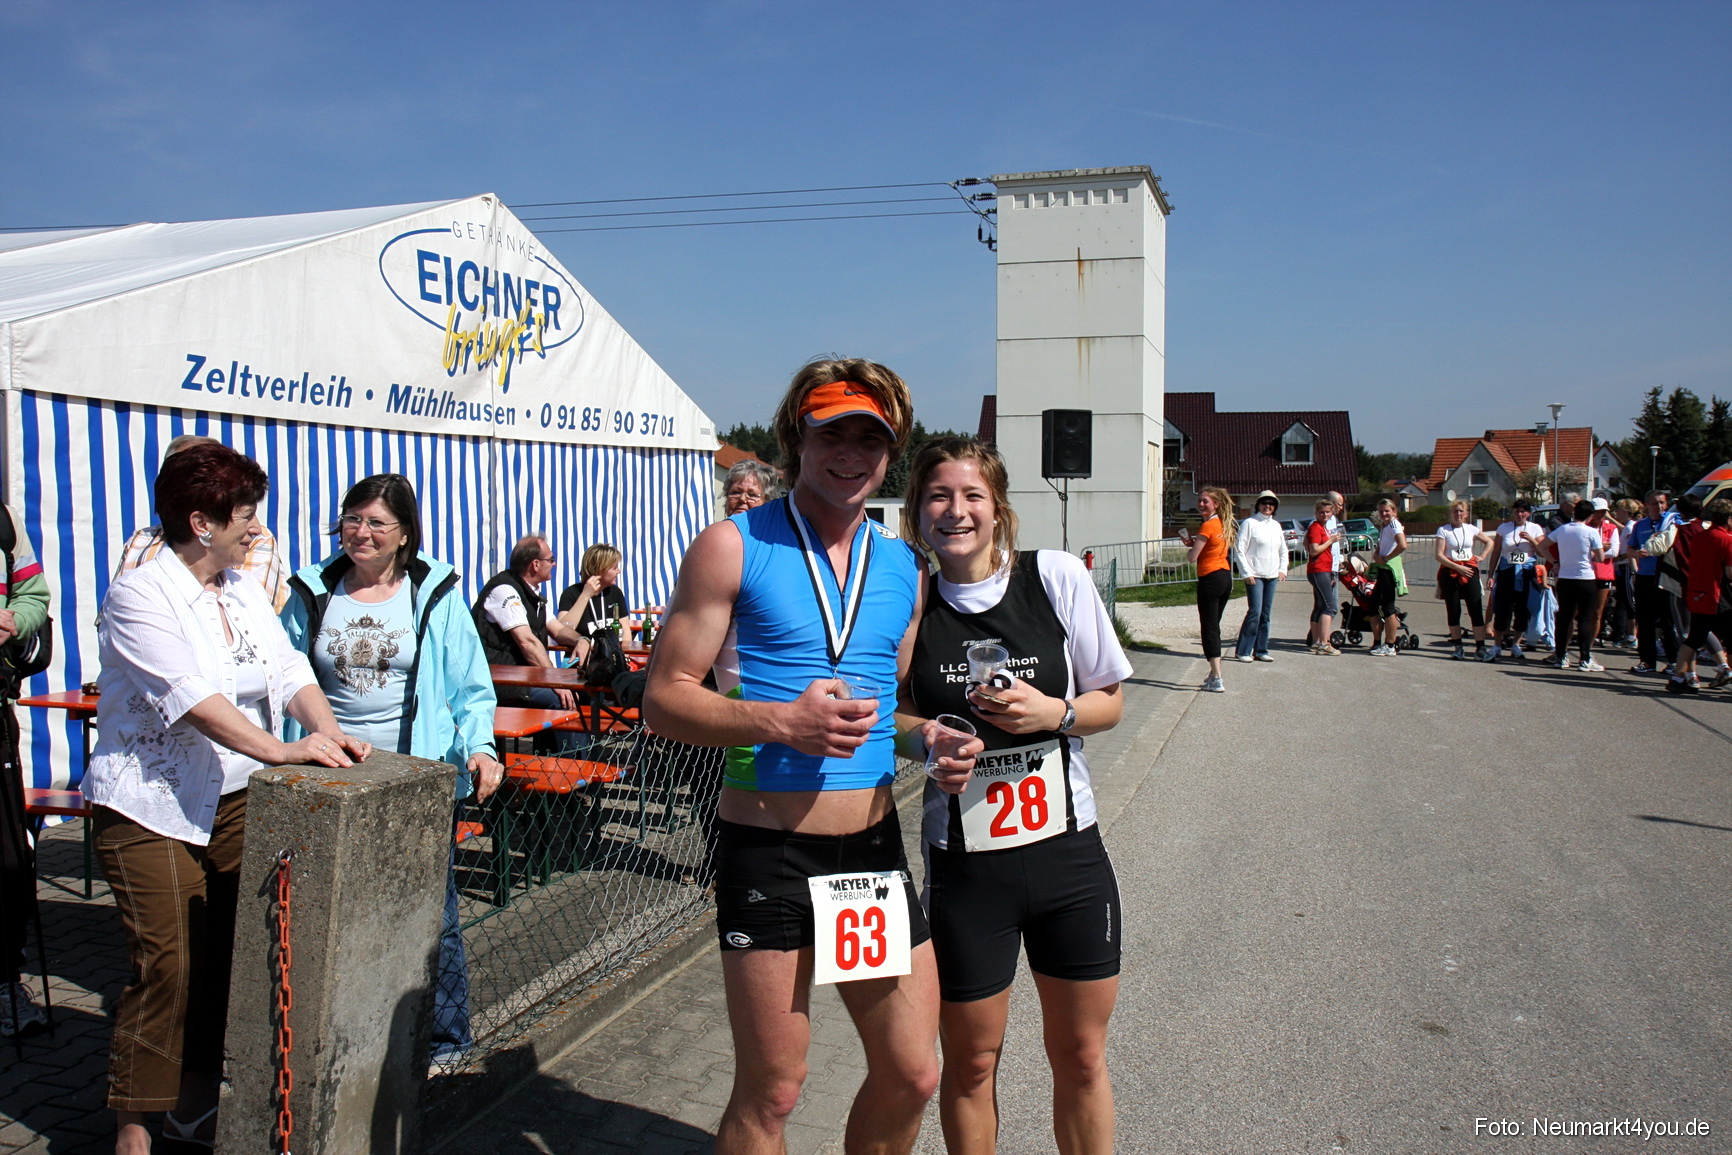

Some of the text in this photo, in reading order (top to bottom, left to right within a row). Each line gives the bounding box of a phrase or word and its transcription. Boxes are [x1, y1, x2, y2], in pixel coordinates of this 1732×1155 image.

[452, 220, 536, 263] GETRÄNKE
[416, 248, 562, 331] EICHNER
[181, 353, 353, 409] Zeltverleih
[386, 383, 516, 426] Mühlhausen
[1510, 552, 1526, 562] 129
[940, 663, 968, 673] LLC
[974, 752, 1023, 770] MEYER
[973, 764, 1025, 778] WERBUNG
[985, 775, 1049, 838] 28
[828, 877, 871, 892] MEYER
[830, 889, 873, 902] WERBUNG
[835, 905, 887, 971] 63
